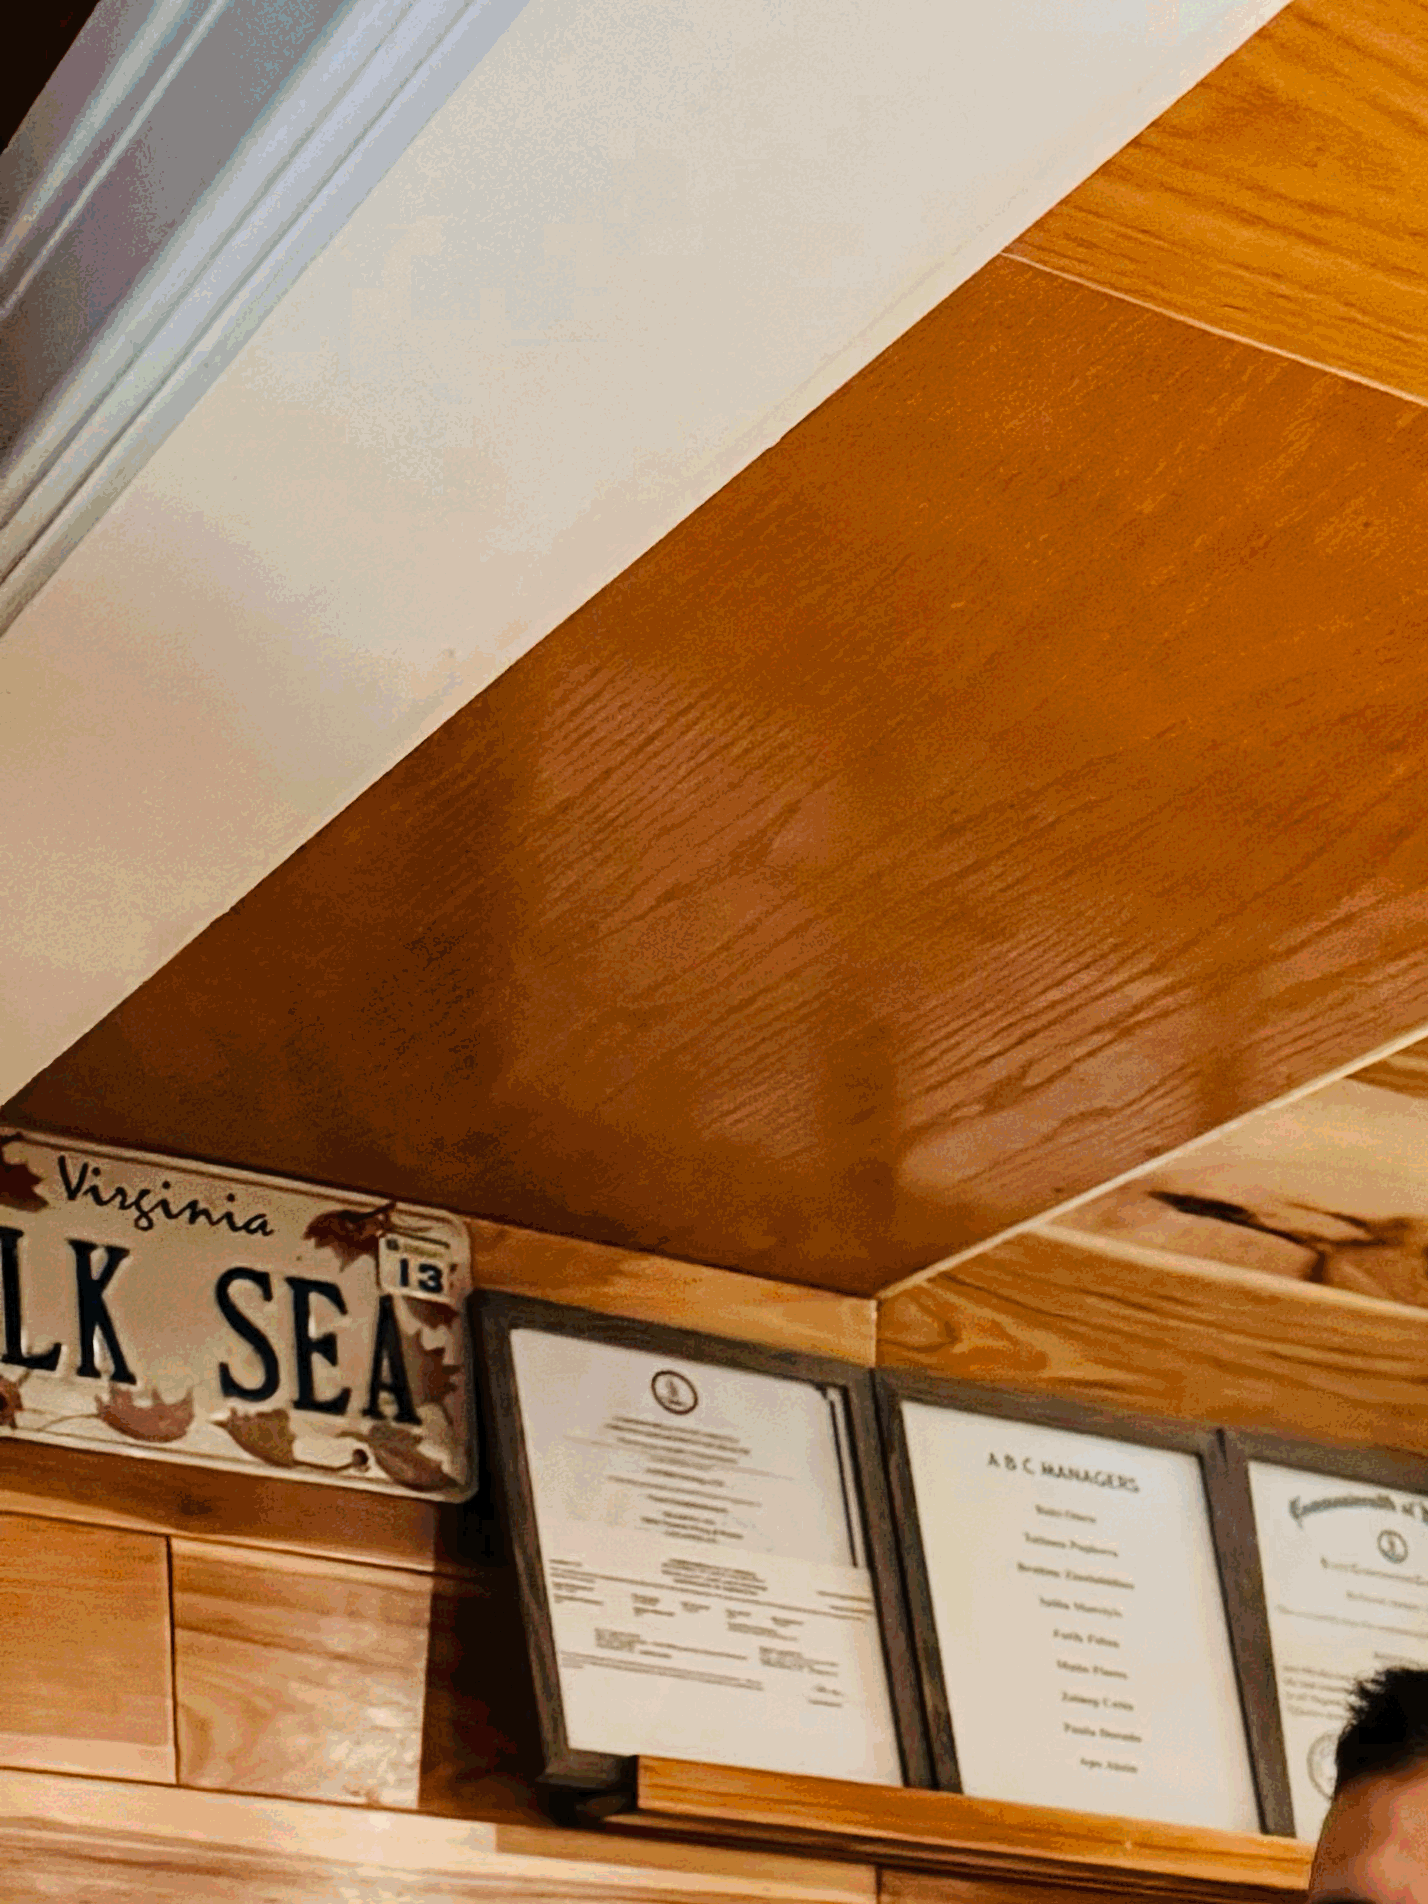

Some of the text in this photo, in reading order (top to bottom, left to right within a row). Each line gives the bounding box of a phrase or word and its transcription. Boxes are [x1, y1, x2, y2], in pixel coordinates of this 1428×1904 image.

[57, 1155, 275, 1238] Virginia
[399, 1259, 444, 1293] 13
[212, 1265, 422, 1427] SEA
[1041, 1461, 1140, 1493] MANAGERS
